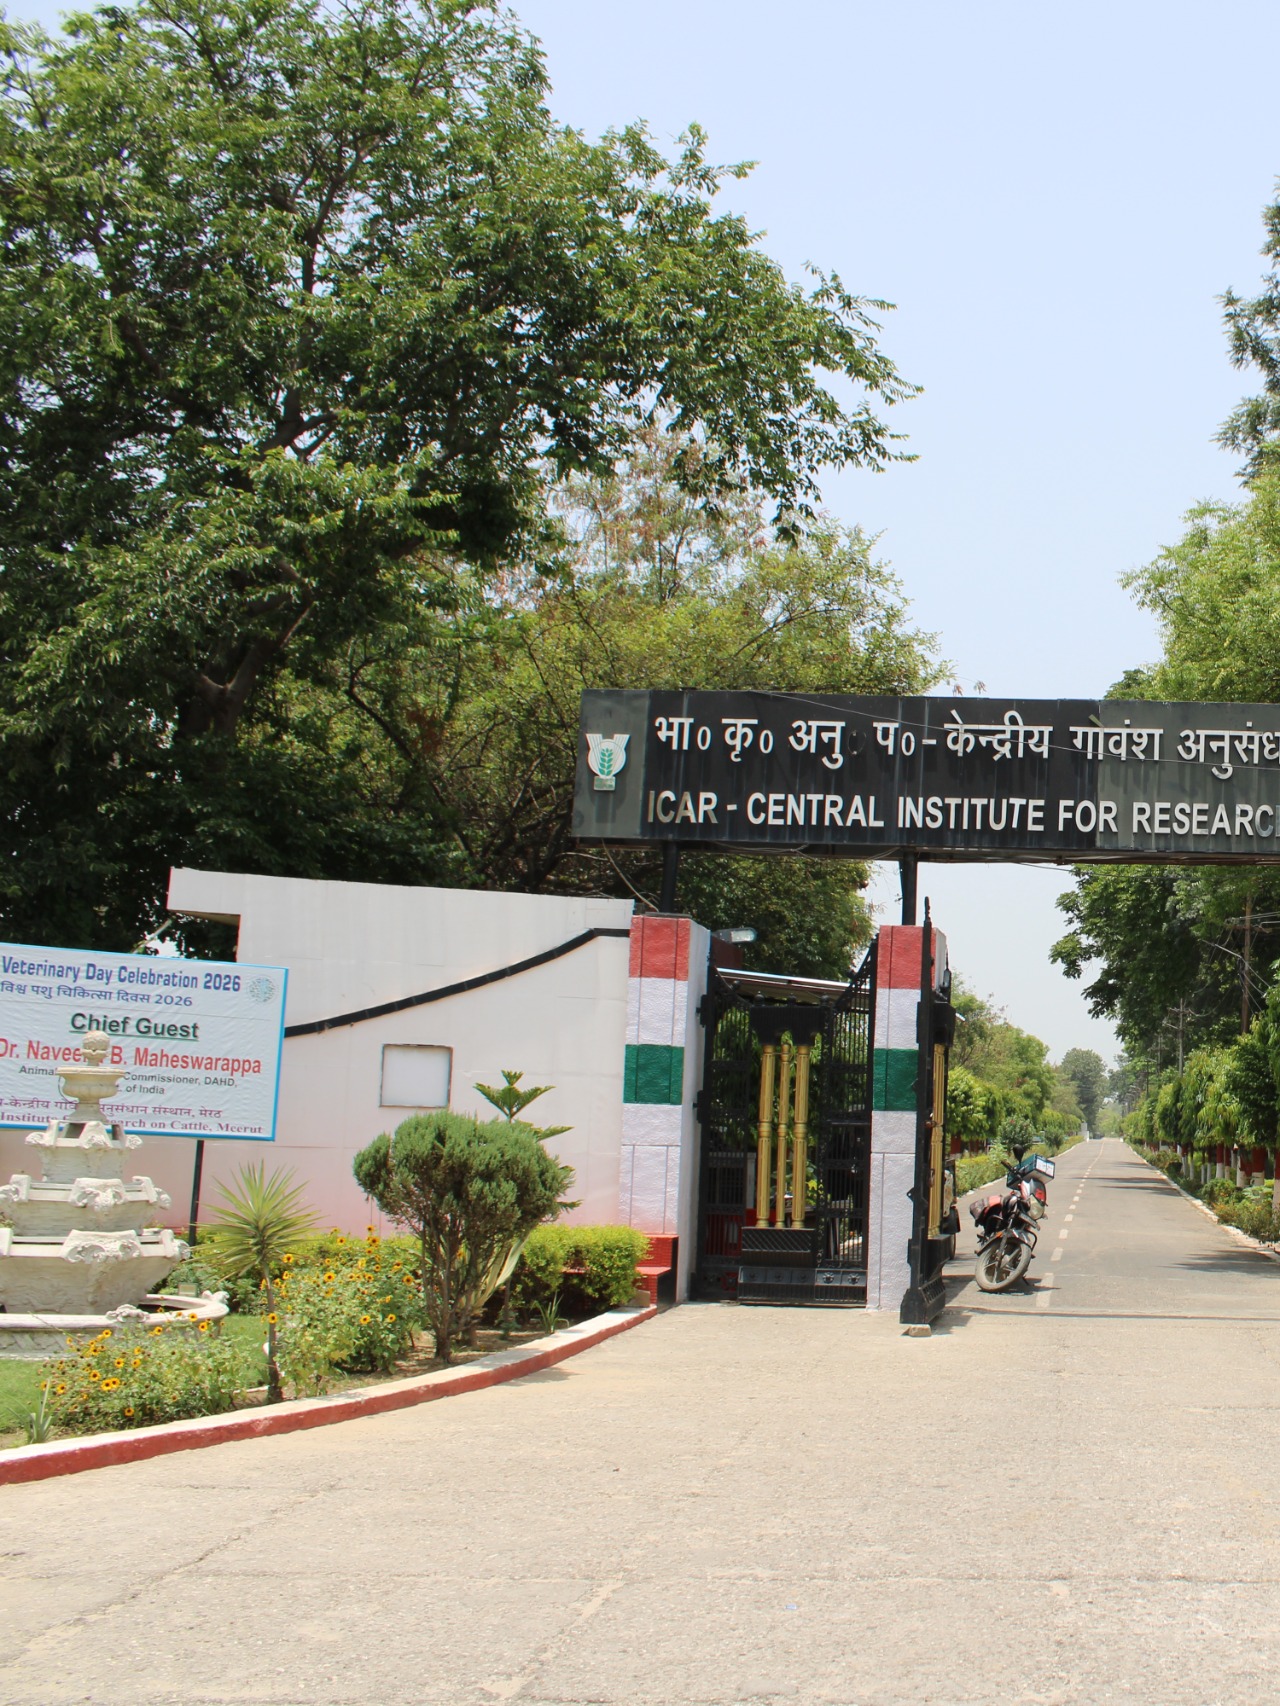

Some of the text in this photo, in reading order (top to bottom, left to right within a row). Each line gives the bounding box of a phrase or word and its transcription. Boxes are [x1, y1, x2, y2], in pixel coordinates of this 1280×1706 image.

[1069, 714, 1164, 761] गोवंश
[747, 792, 884, 828] CENTRAL
[898, 796, 1045, 832] INSTITUTE
[1058, 800, 1118, 833] FOR
[2, 955, 80, 983] Veterinary
[85, 963, 113, 985] Day
[117, 965, 198, 989] Celebration
[203, 972, 241, 992] 2026
[0, 981, 193, 1007] विश्व पशु चिकित्सा दिवस 2026
[70, 1012, 200, 1039] Chief Guest
[110, 1045, 127, 1065] B.
[134, 1047, 261, 1077] Maheswarappa
[123, 1071, 201, 1085] Commissioner,
[204, 1076, 238, 1088] DAHD,
[125, 1085, 137, 1093] of
[139, 1085, 165, 1095] India
[199, 1105, 223, 1119] मेरठ
[151, 1121, 166, 1130] on
[170, 1120, 213, 1132] Cattle,
[216, 1122, 263, 1134] Meerut
